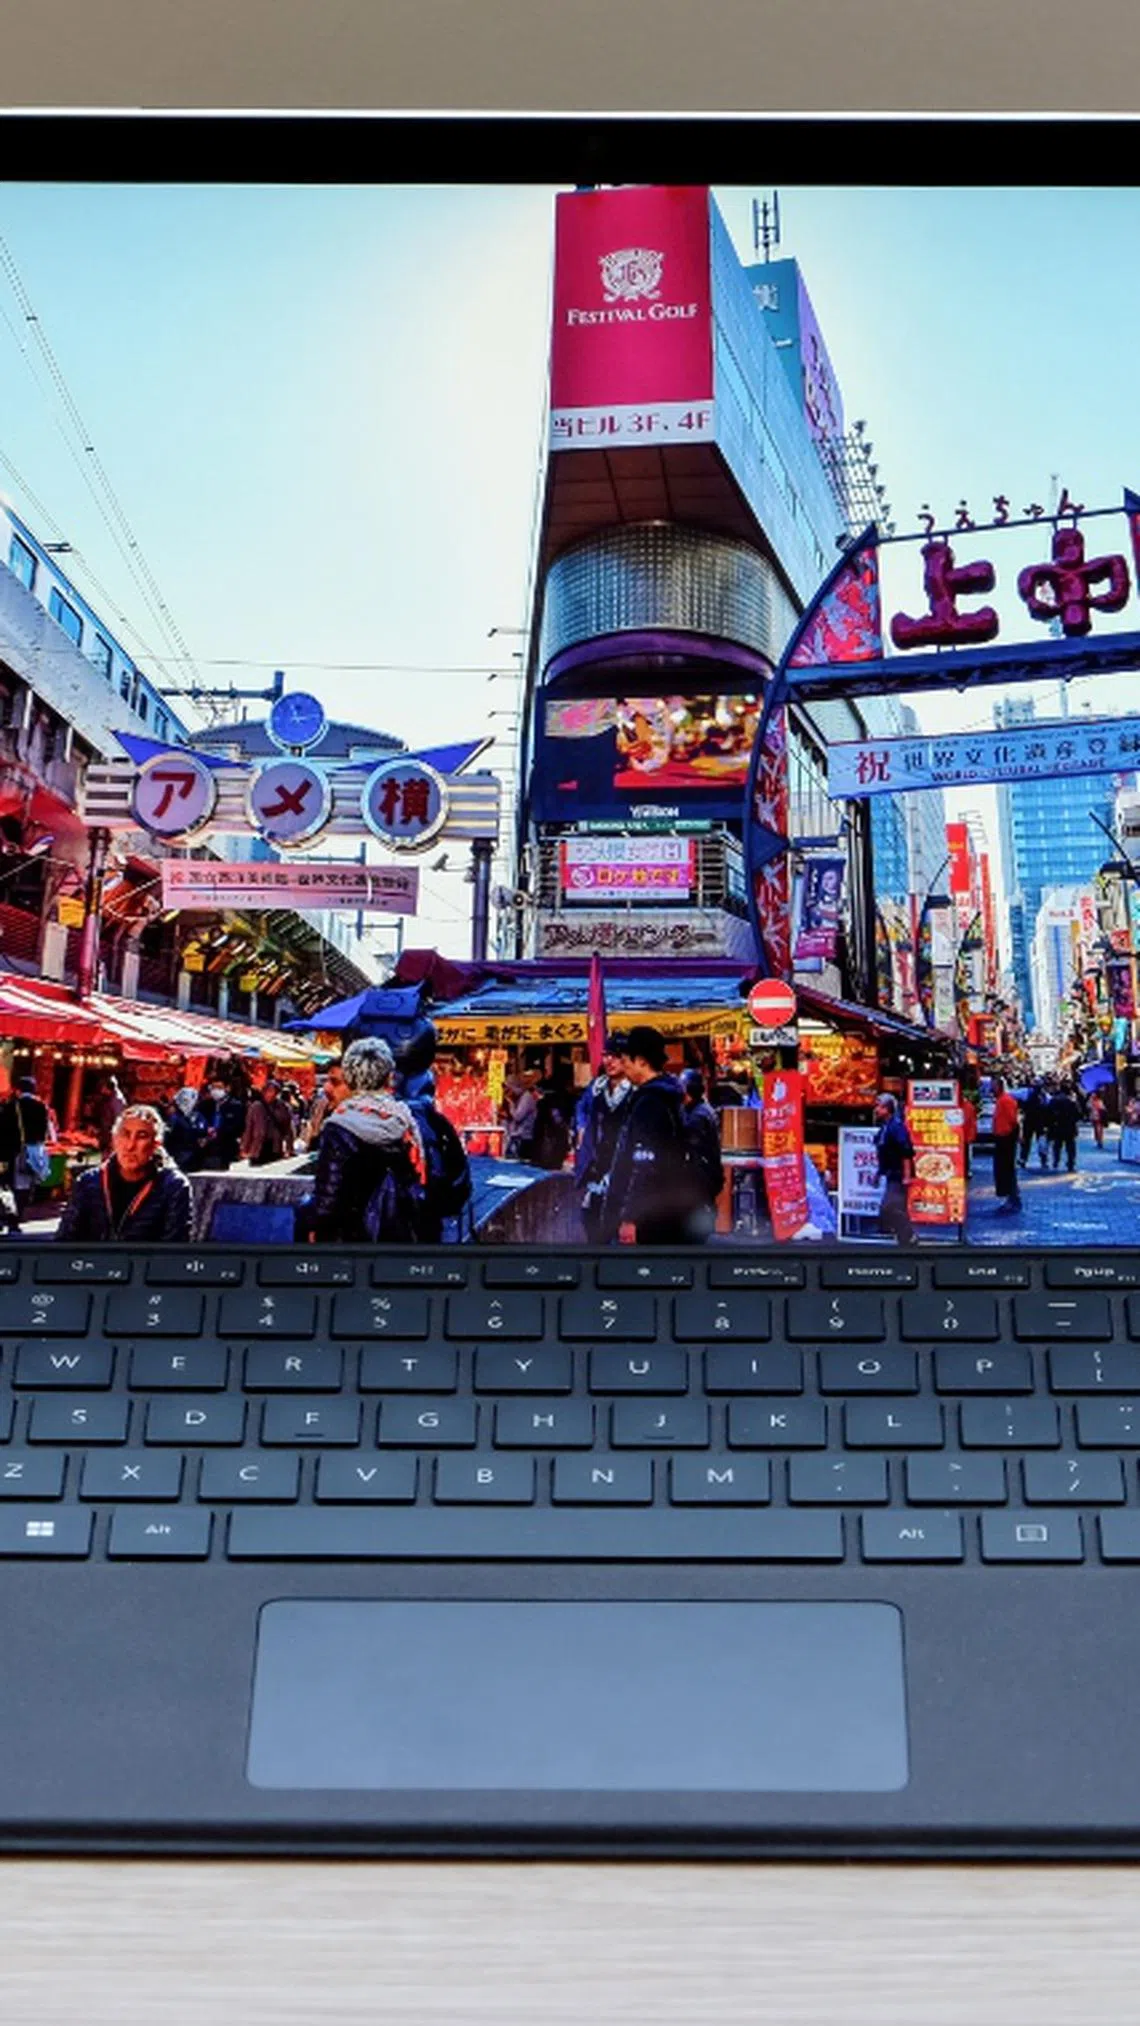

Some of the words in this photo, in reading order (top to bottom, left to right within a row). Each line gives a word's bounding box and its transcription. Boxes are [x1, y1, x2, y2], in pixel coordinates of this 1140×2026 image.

[567, 308, 646, 326] FESTIVAL
[647, 302, 698, 320] GOLF
[855, 750, 892, 785] 祝
[150, 771, 431, 826] アメ横
[539, 1022, 584, 1040] まぐろ
[32, 1310, 47, 1324] 2
[147, 1313, 160, 1326] 3
[259, 1314, 273, 1326] 4
[374, 1316, 387, 1328] 5
[487, 1316, 503, 1329] 6
[605, 1317, 616, 1329] 7
[715, 1316, 730, 1329] 8
[829, 1316, 845, 1329] 9
[943, 1318, 959, 1329] 0
[50, 1355, 80, 1369] W
[171, 1356, 185, 1369] E
[285, 1356, 302, 1371] R
[402, 1358, 417, 1371] T
[516, 1359, 532, 1372] Y
[629, 1360, 649, 1374] U
[857, 1361, 881, 1374] O
[976, 1359, 993, 1373] P
[72, 1409, 88, 1422] S
[185, 1411, 207, 1425] D
[305, 1412, 319, 1425] F
[417, 1412, 439, 1427] G
[533, 1414, 554, 1427] H
[654, 1414, 666, 1428] J
[770, 1414, 786, 1427] K
[887, 1415, 901, 1427] L
[3, 1463, 23, 1478] Z
[122, 1465, 141, 1480] X
[239, 1465, 257, 1481] C
[1068, 1460, 1078, 1473] ?
[356, 1467, 377, 1481] V
[477, 1468, 494, 1484] B
[592, 1469, 614, 1483] N
[707, 1468, 734, 1483] M
[145, 1524, 171, 1534] Alt
[898, 1528, 925, 1539] Alt
